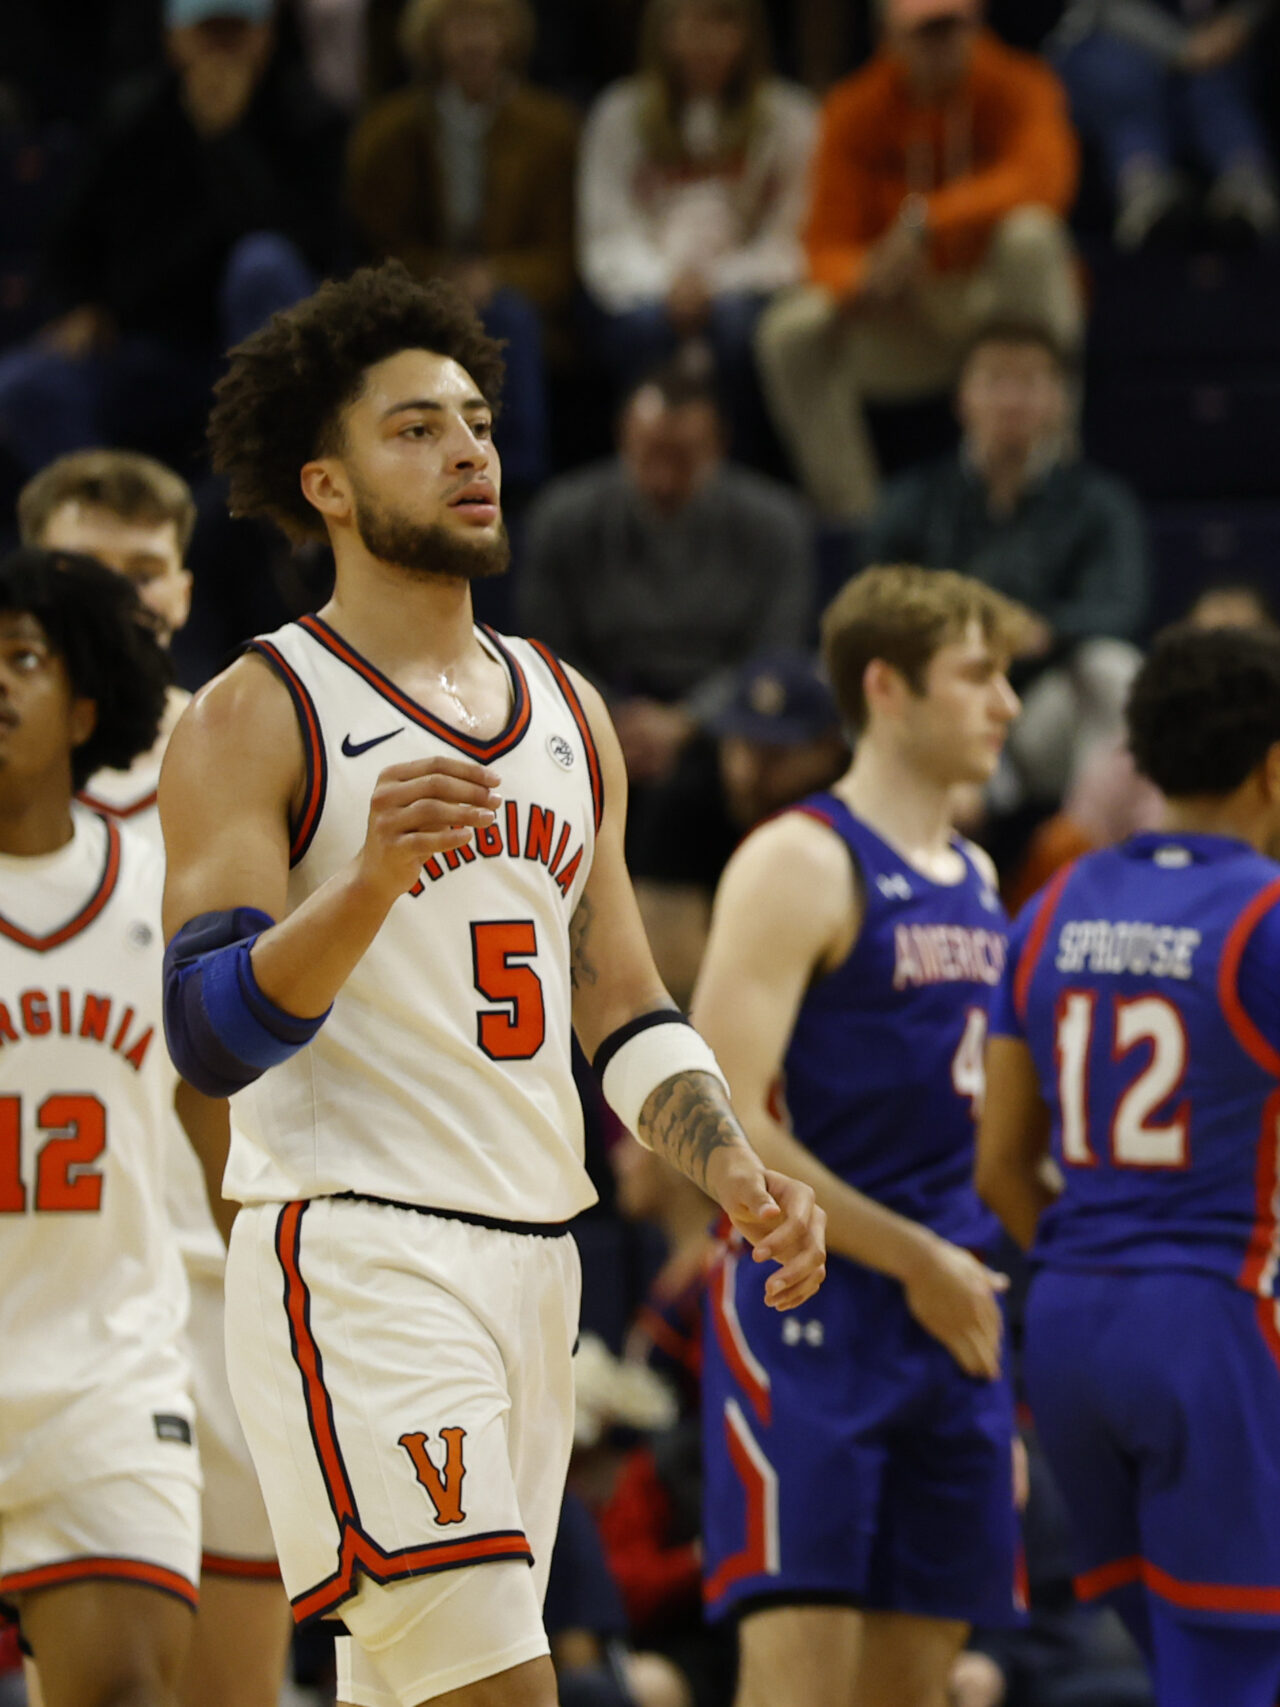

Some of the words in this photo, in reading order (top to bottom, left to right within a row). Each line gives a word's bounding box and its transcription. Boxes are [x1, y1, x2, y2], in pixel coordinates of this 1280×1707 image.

[408, 800, 583, 898] RGINIA
[469, 920, 545, 1060] 5
[1055, 919, 1201, 980] SPROUSE
[1054, 987, 1192, 1168] 12
[0, 1094, 107, 1213] 12
[398, 1426, 467, 1526] V
